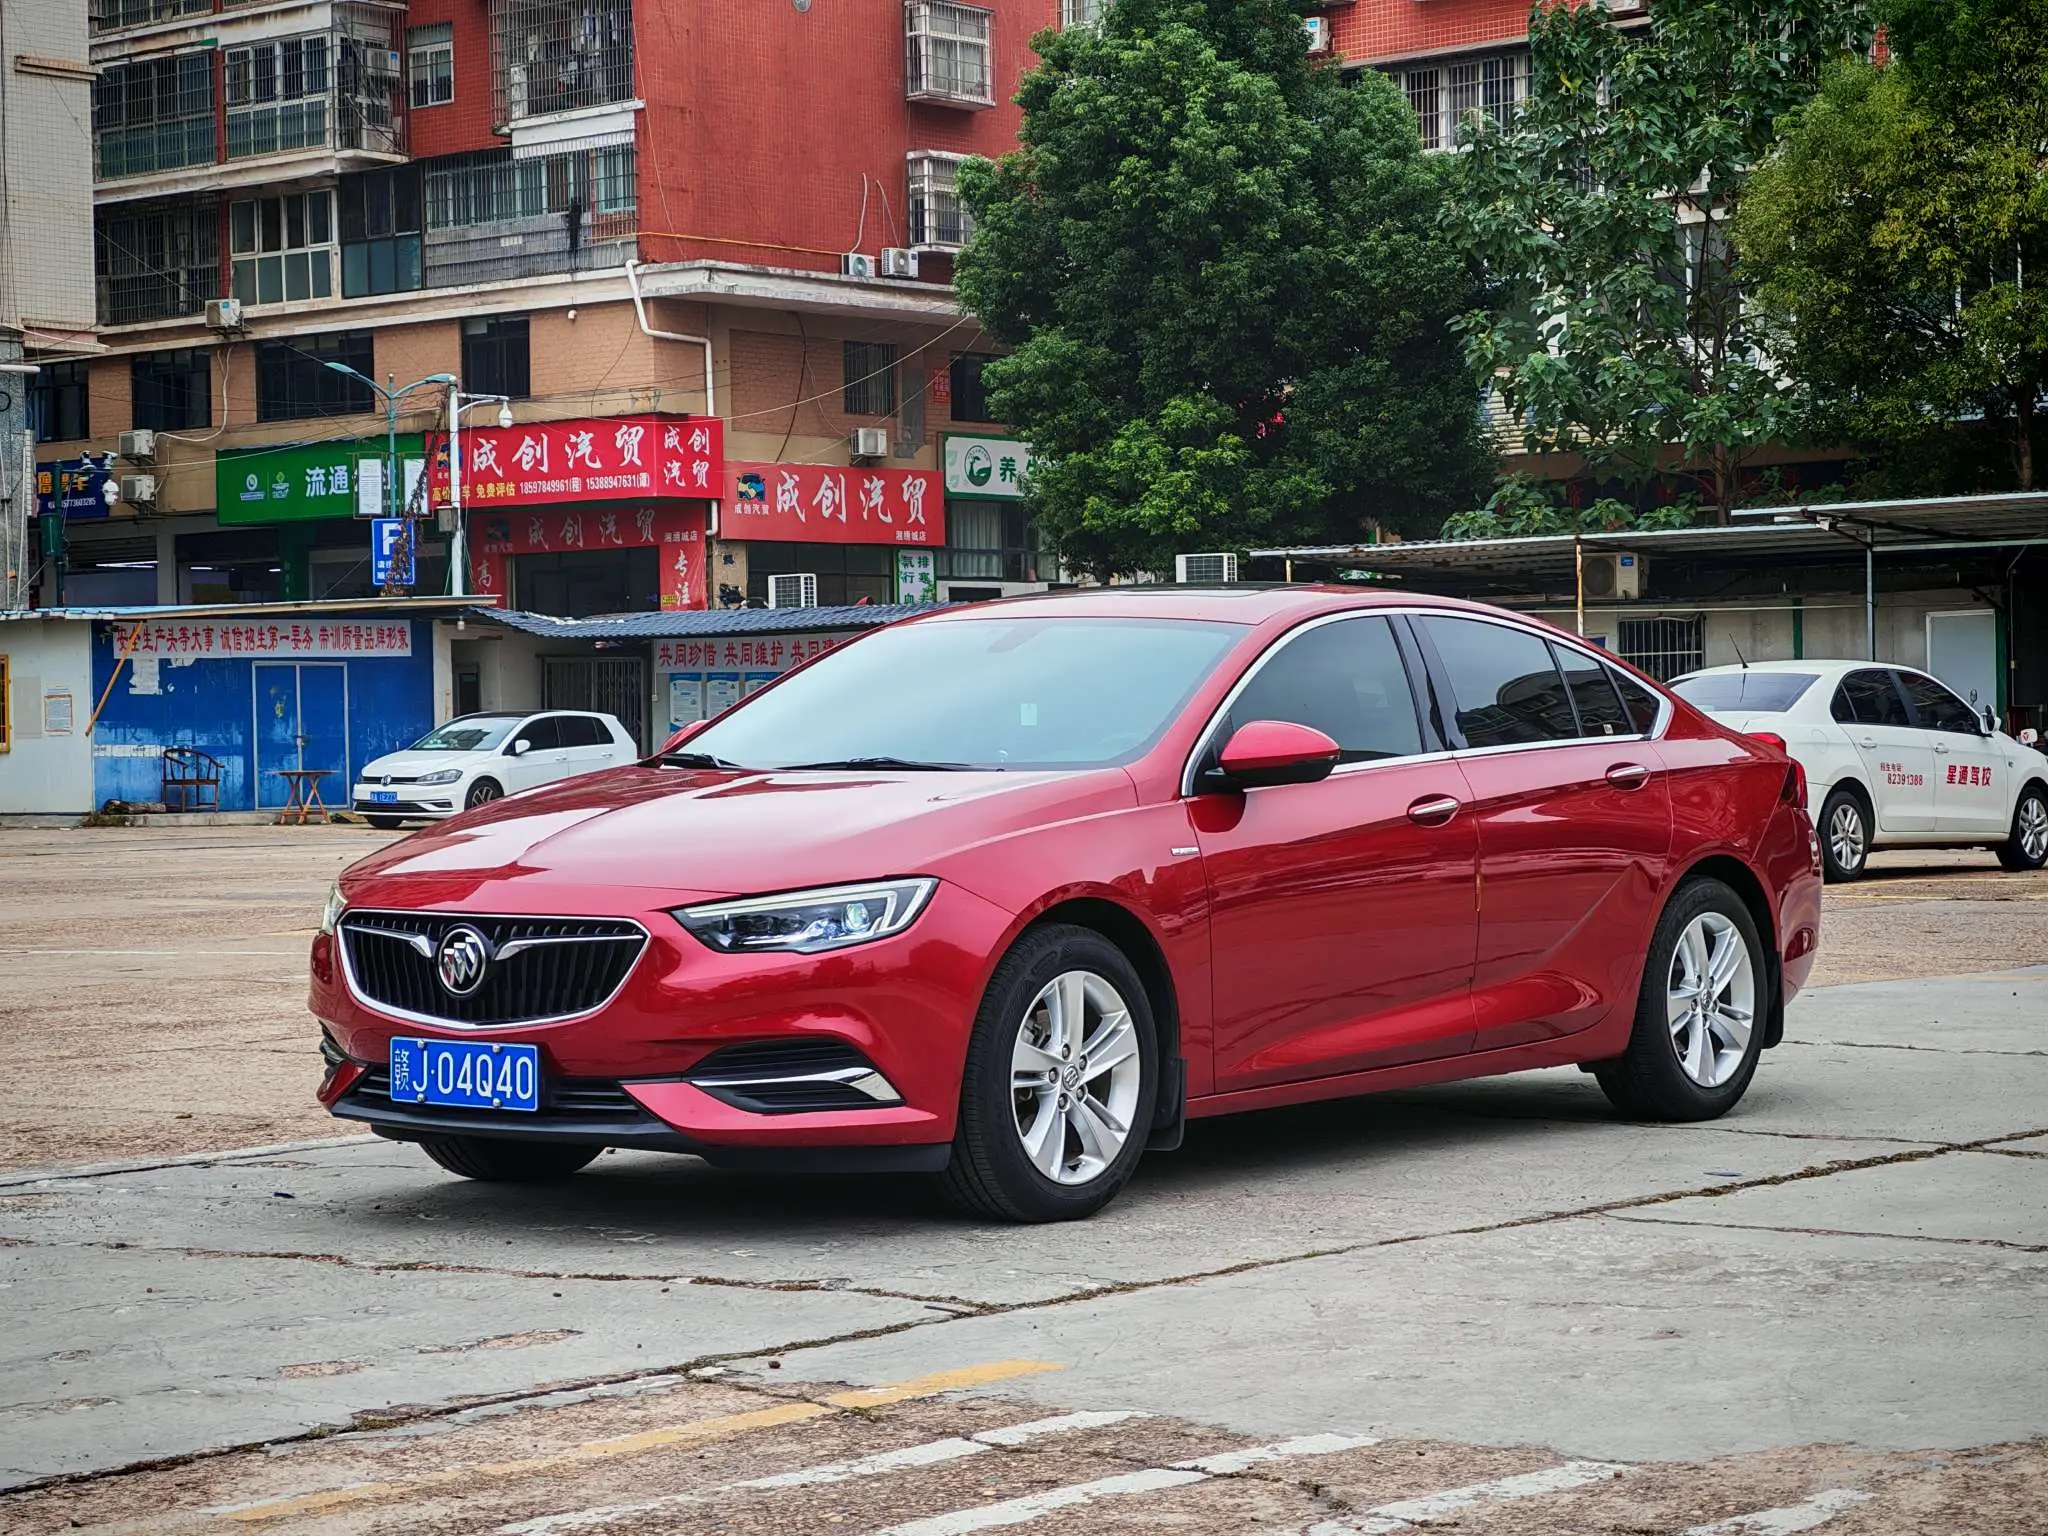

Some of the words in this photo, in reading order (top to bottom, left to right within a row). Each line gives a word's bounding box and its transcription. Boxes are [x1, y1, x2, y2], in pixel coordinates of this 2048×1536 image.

[473, 424, 645, 478] 成创汽贸
[663, 425, 710, 455] 成创
[663, 460, 711, 488] 汽贸
[432, 484, 471, 502] 高价车
[476, 482, 516, 499] 免费评估
[776, 470, 928, 526] 成创汽贸
[528, 508, 656, 551] 成创汽贸
[116, 625, 214, 652] 安全生产头等大事
[220, 625, 314, 652] 诚信招生第一要务
[659, 641, 717, 667] 共同珍惜
[724, 640, 784, 667] 共同维护
[1887, 773, 1924, 786] 82391388
[1946, 764, 1993, 787] 星通驾校
